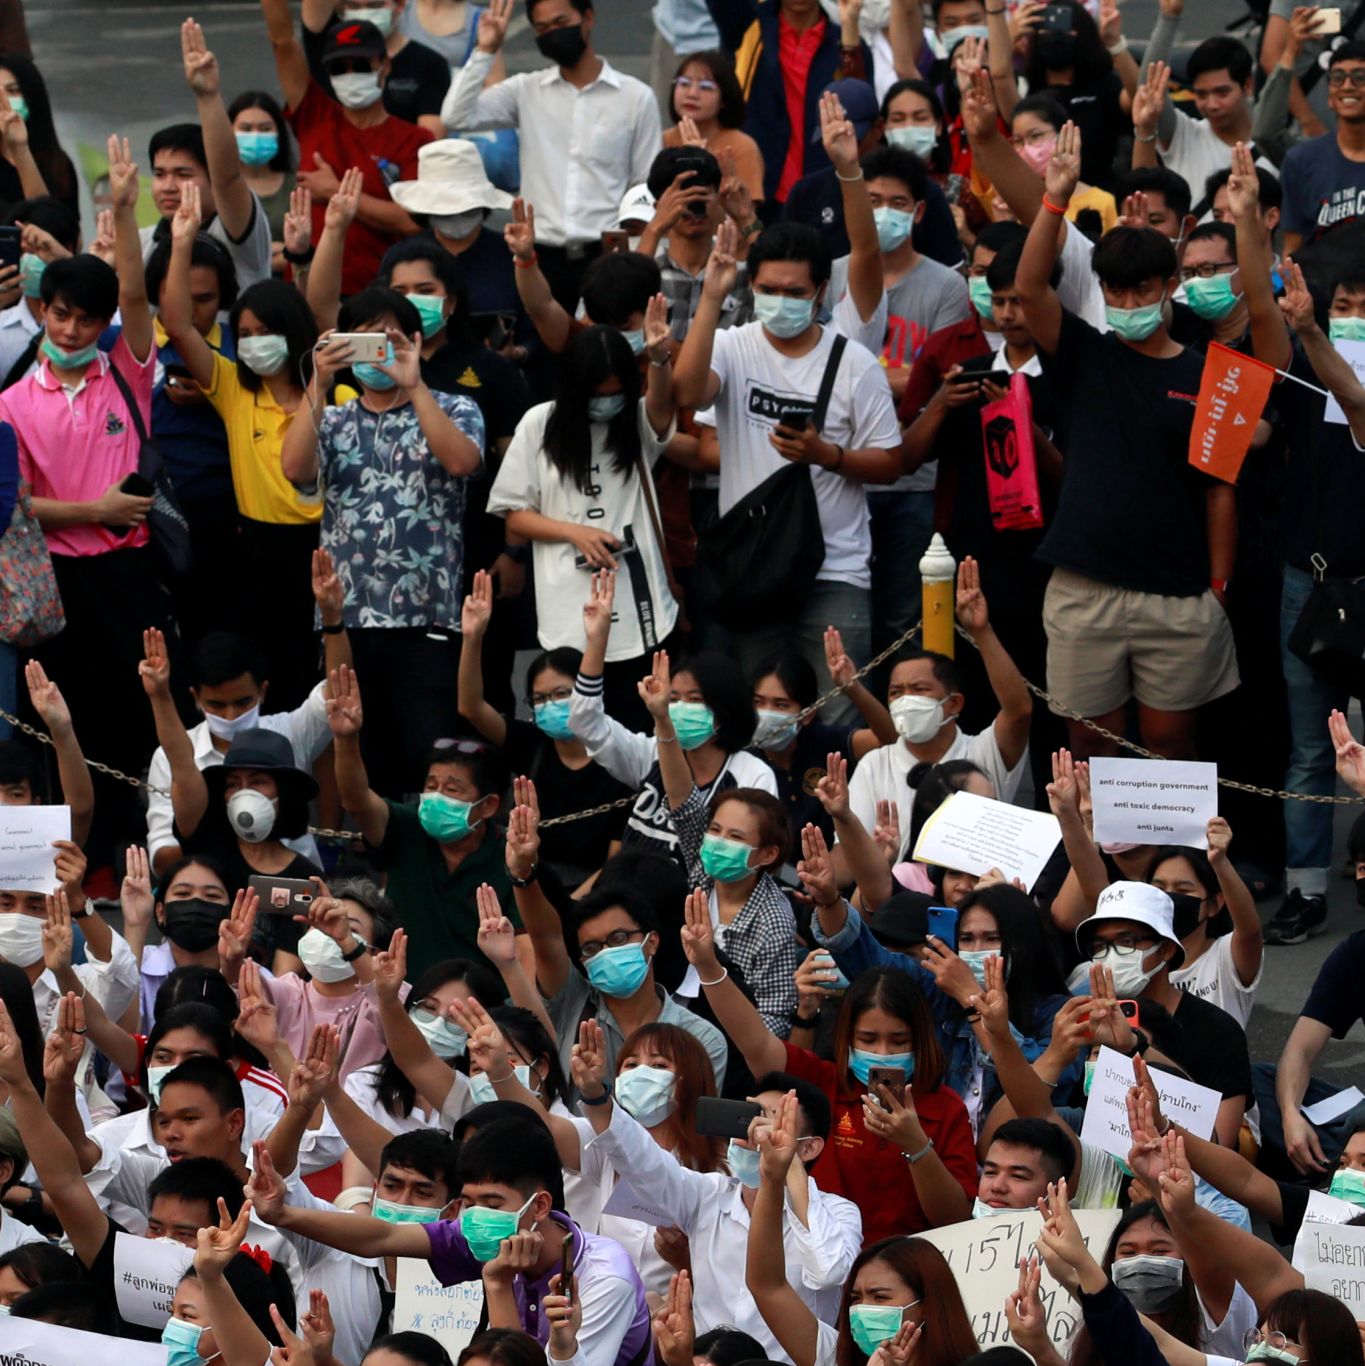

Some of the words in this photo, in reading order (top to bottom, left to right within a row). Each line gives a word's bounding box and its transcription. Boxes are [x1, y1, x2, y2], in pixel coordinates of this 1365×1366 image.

[1317, 198, 1356, 227] QUEEN
[1099, 778, 1115, 787] anti
[1116, 779, 1159, 791] corruption
[1160, 782, 1209, 792] government
[1113, 801, 1129, 809] anti
[1130, 802, 1150, 811] toxic
[1151, 803, 1196, 813] democracy
[1136, 823, 1152, 832] anti
[1153, 823, 1175, 833] junta
